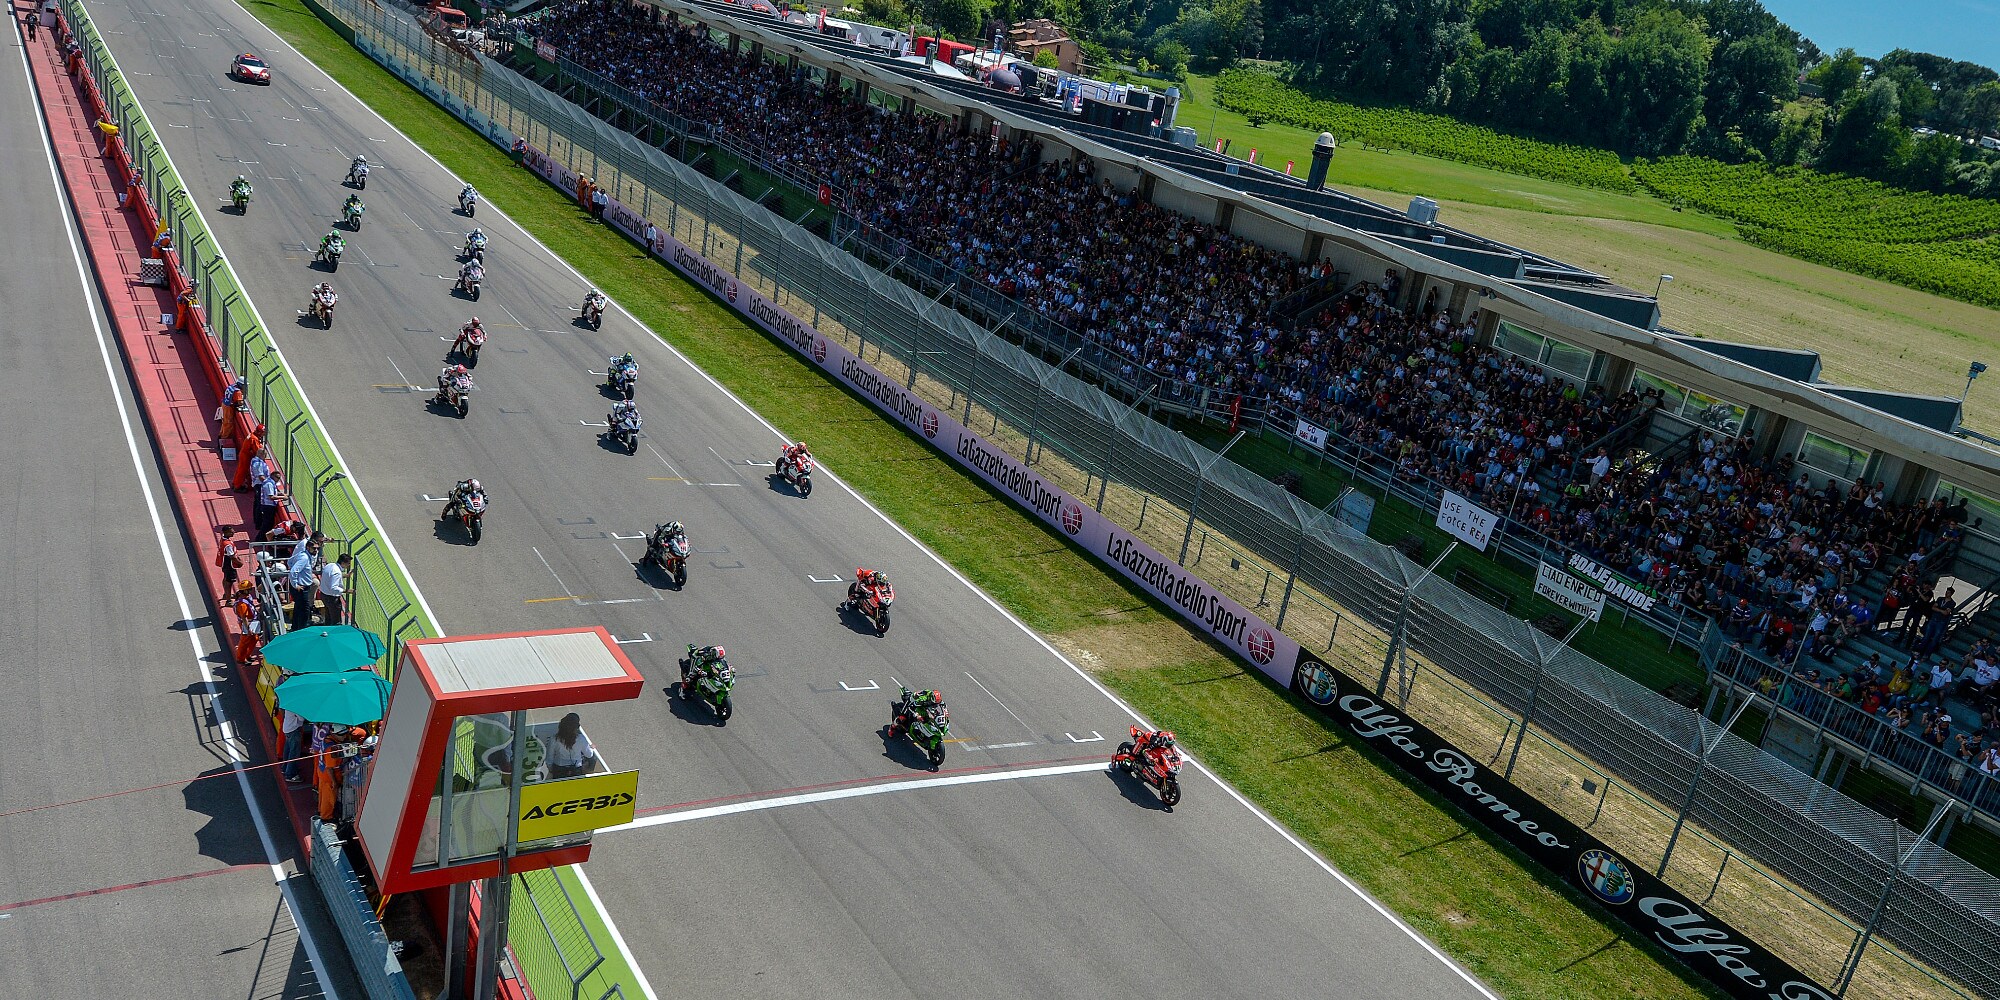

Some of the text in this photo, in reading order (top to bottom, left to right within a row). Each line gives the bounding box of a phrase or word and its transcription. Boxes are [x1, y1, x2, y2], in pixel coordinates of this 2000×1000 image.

[780, 315, 796, 341] dello
[795, 324, 814, 354] Sport
[881, 382, 900, 412] dello
[899, 392, 922, 428] Sport
[1008, 466, 1032, 502] dello
[1031, 480, 1061, 521] Sport
[1444, 500, 1486, 528] USE THE
[1470, 527, 1486, 544] REA
[1542, 565, 1601, 603] CIAO ENRICO
[1175, 577, 1207, 618] dello
[1205, 595, 1246, 646] Sport
[1339, 695, 1570, 849] Alfa Romeo
[1638, 896, 1767, 989] Alfa
